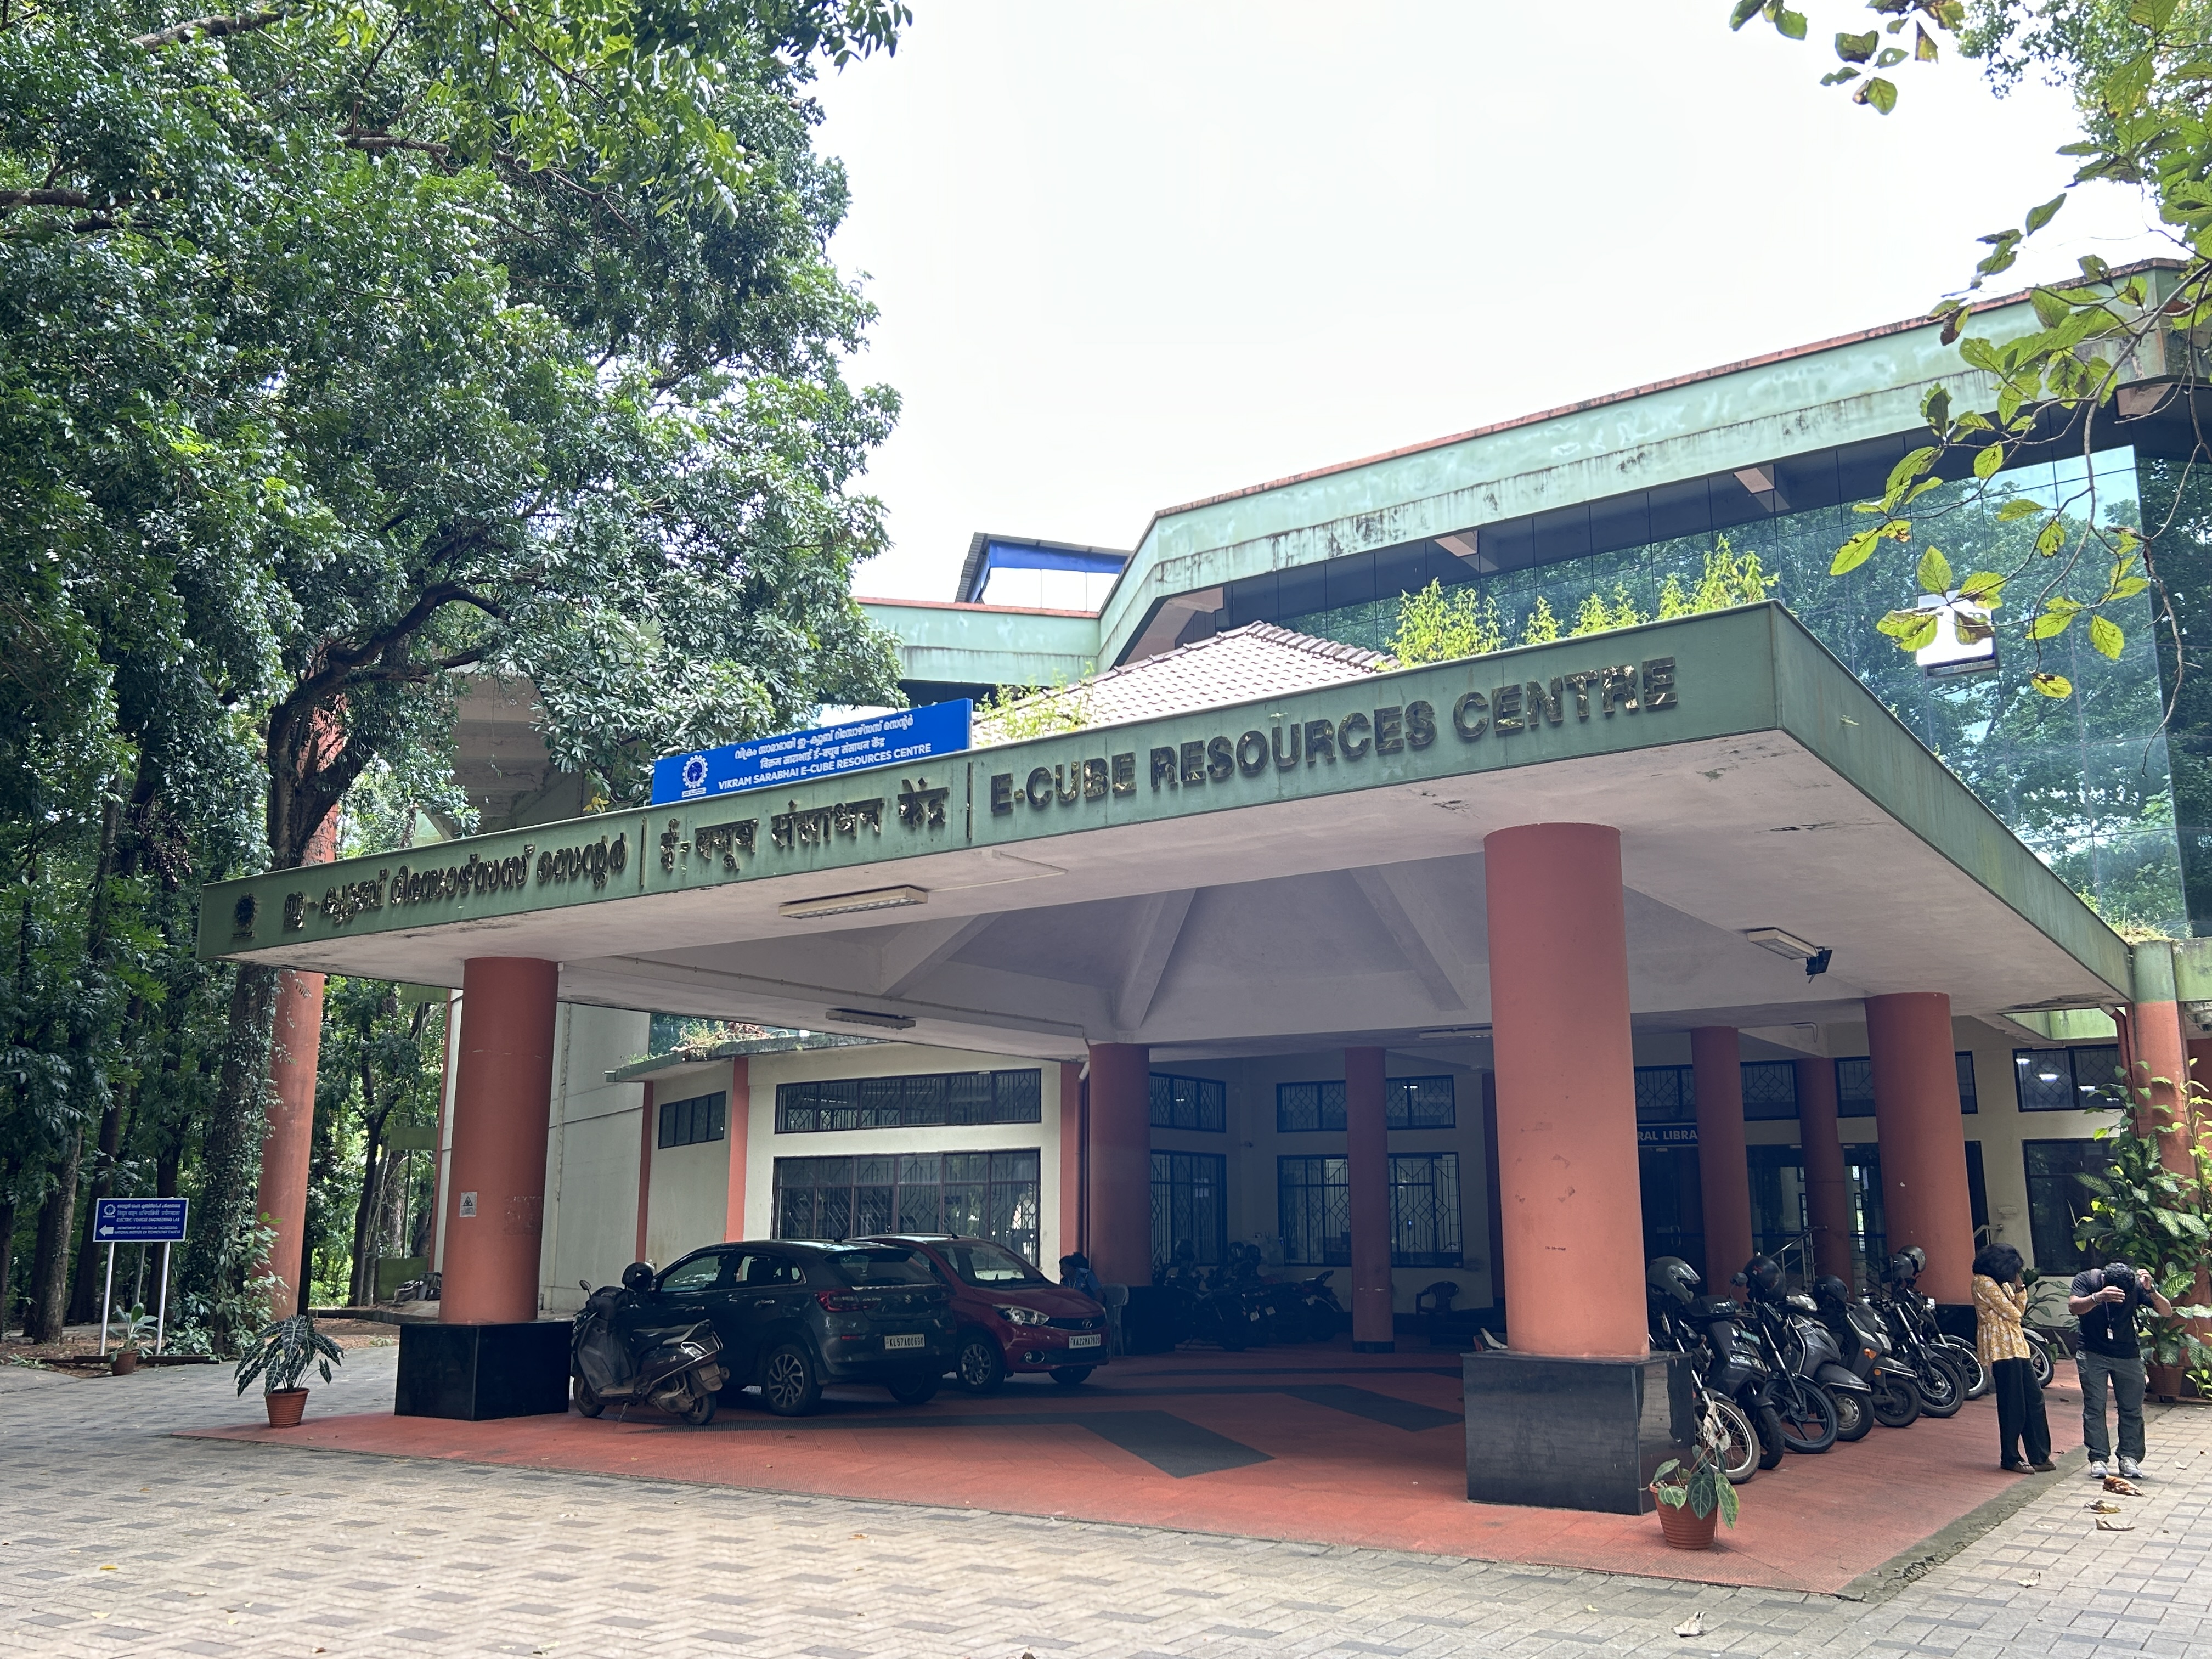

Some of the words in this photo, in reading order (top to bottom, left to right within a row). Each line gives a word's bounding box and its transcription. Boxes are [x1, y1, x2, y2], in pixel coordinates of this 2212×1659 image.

[760, 754, 782, 769] विक्रम
[783, 748, 813, 765] साराभाई
[841, 742, 870, 754] संसाधन
[990, 751, 1137, 816] E-CUBE
[1150, 700, 1438, 790] RESOURCES
[1453, 657, 1679, 742] CENTRE
[719, 776, 752, 790] VIKRAM
[753, 768, 799, 783] SARABHAI
[800, 761, 835, 776] E-CUBE
[837, 751, 892, 769] RESOURCES
[894, 743, 932, 758] CENTRE
[771, 798, 885, 847] संसाधन
